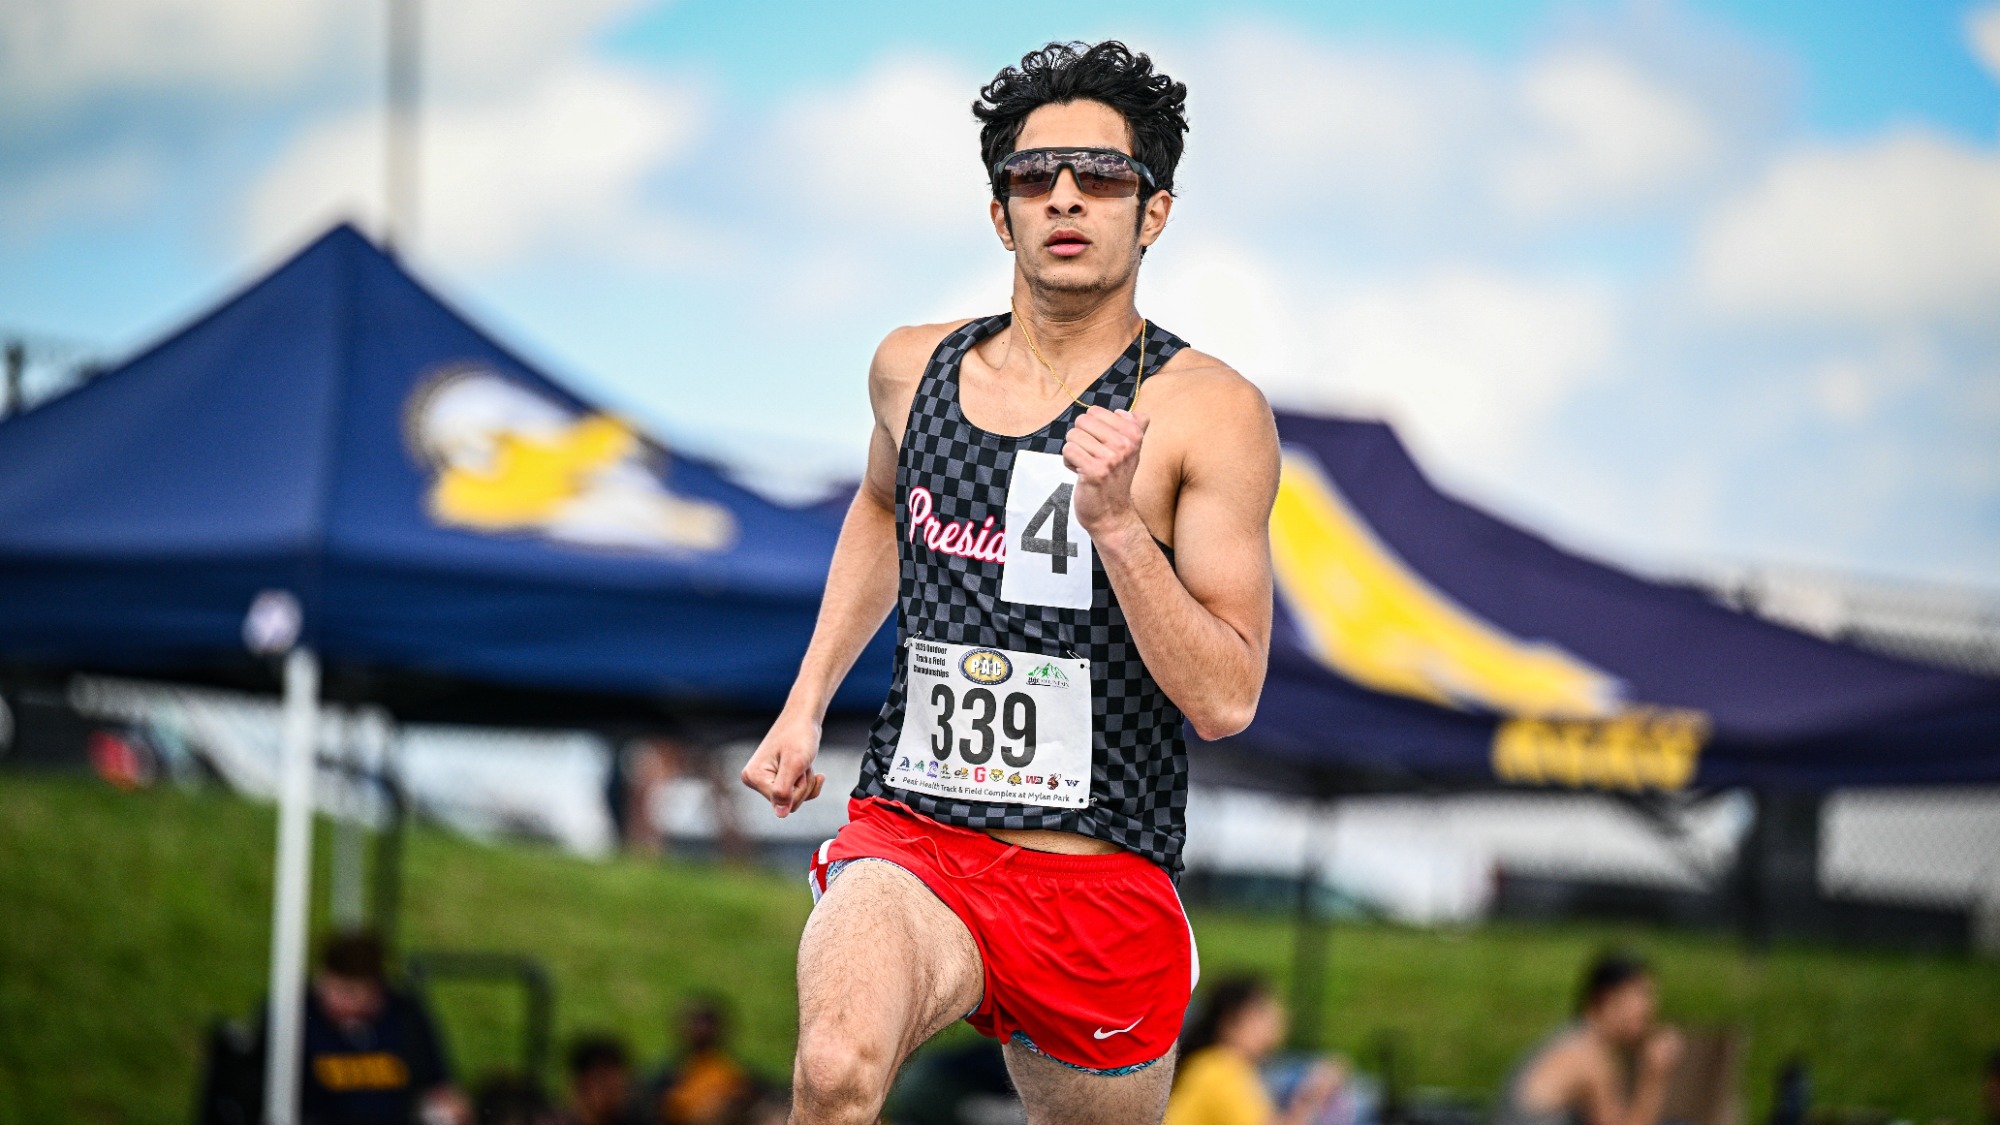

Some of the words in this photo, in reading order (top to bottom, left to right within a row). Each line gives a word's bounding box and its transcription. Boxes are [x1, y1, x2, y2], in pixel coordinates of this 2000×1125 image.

[1020, 482, 1078, 575] 4
[926, 644, 948, 655] Outdoor
[915, 653, 928, 663] Track
[932, 656, 946, 666] Field
[970, 658, 1002, 676] PAC
[913, 664, 950, 679] Championships
[931, 683, 1037, 768] 339
[902, 776, 918, 787] Peak
[919, 780, 941, 791] Health
[941, 785, 957, 793] Track
[964, 787, 982, 796] Field
[983, 789, 1017, 799] Complex
[1027, 791, 1051, 802] Mylan
[1053, 793, 1070, 803] Park
